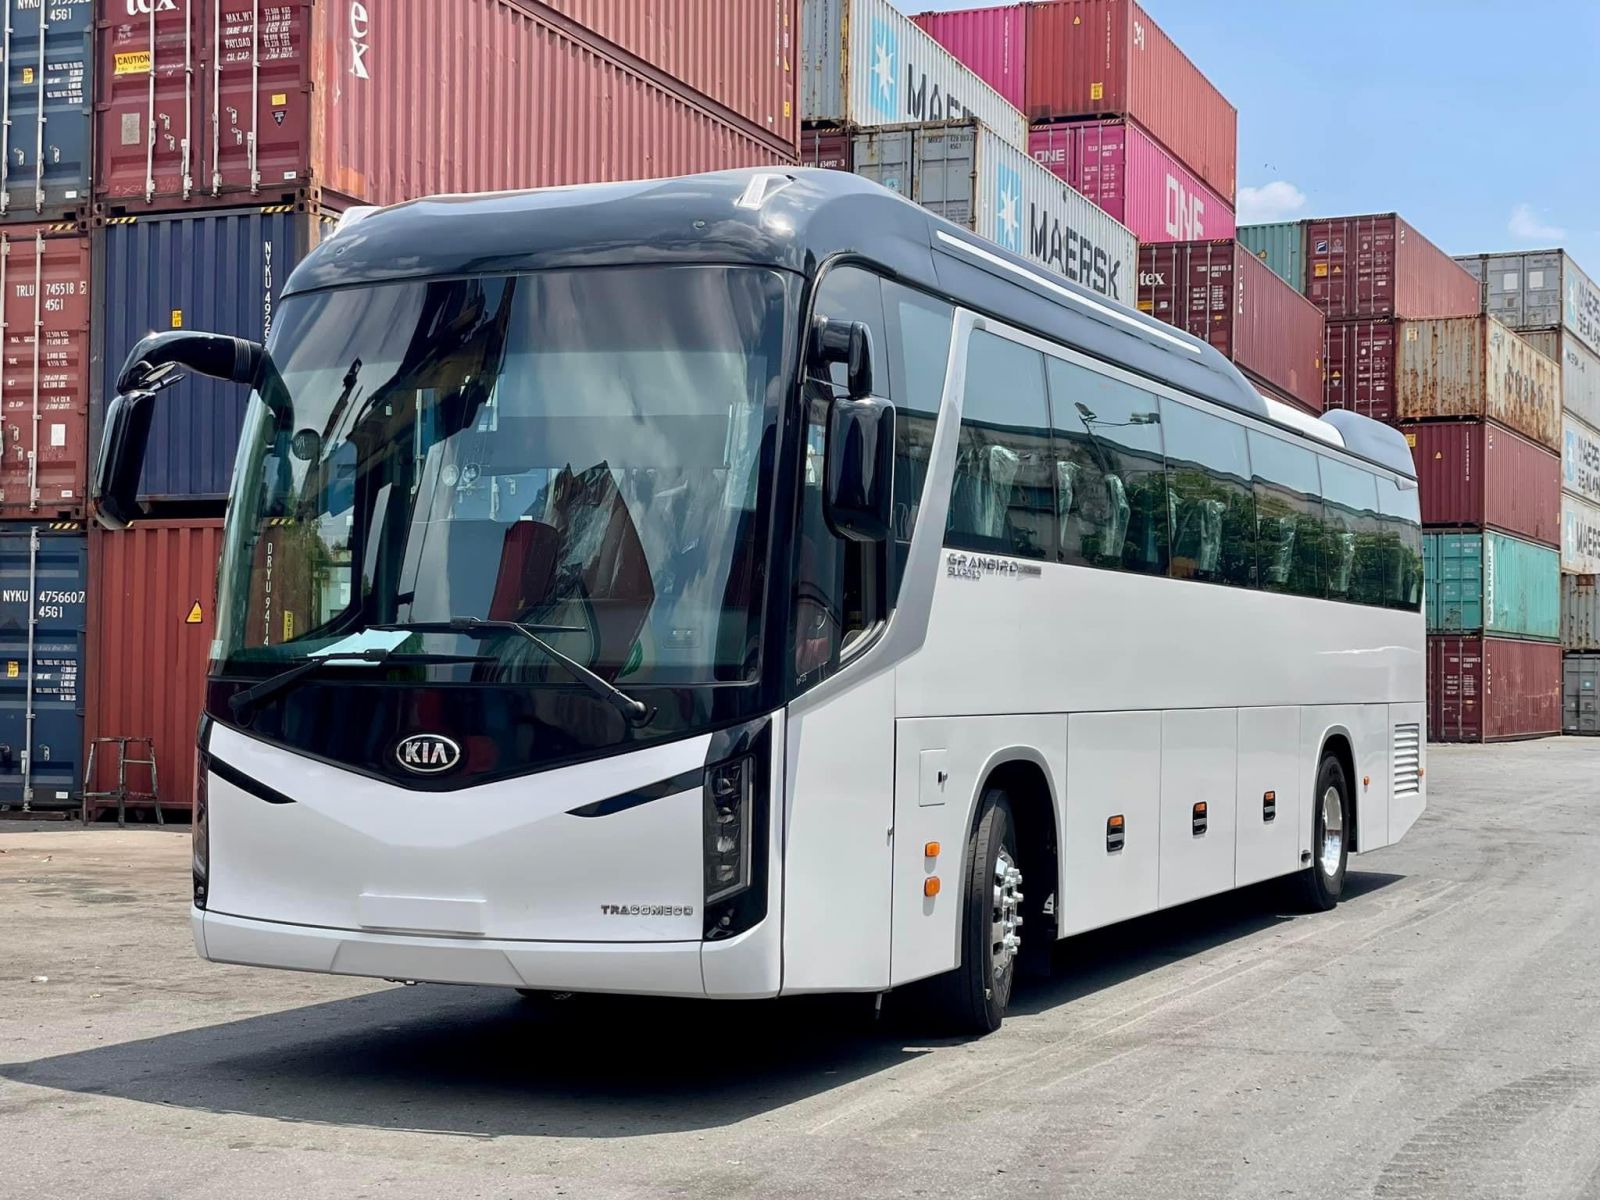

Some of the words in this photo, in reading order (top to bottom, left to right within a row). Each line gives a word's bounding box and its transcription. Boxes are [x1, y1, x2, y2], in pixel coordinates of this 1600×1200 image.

[50, 8, 72, 21] 45G1
[224, 37, 251, 49] PAYLOAD
[117, 53, 150, 65] CAUTION
[1034, 149, 1065, 163] ONE
[1165, 173, 1205, 241] ONE
[1030, 202, 1121, 301] MAERSK
[264, 241, 272, 289] NYKU
[1139, 270, 1166, 286] tex
[16, 284, 35, 297] TRLU
[45, 282, 75, 296] 745518
[44, 298, 64, 311] 45G1
[265, 542, 273, 593] DRYU
[947, 553, 1019, 572] GRANBIRD
[3, 590, 29, 602] NYKU
[38, 606, 63, 618] 45G1
[263, 597, 271, 646] 9414
[405, 742, 448, 764] KIA
[600, 904, 694, 917] TRACOMECO
